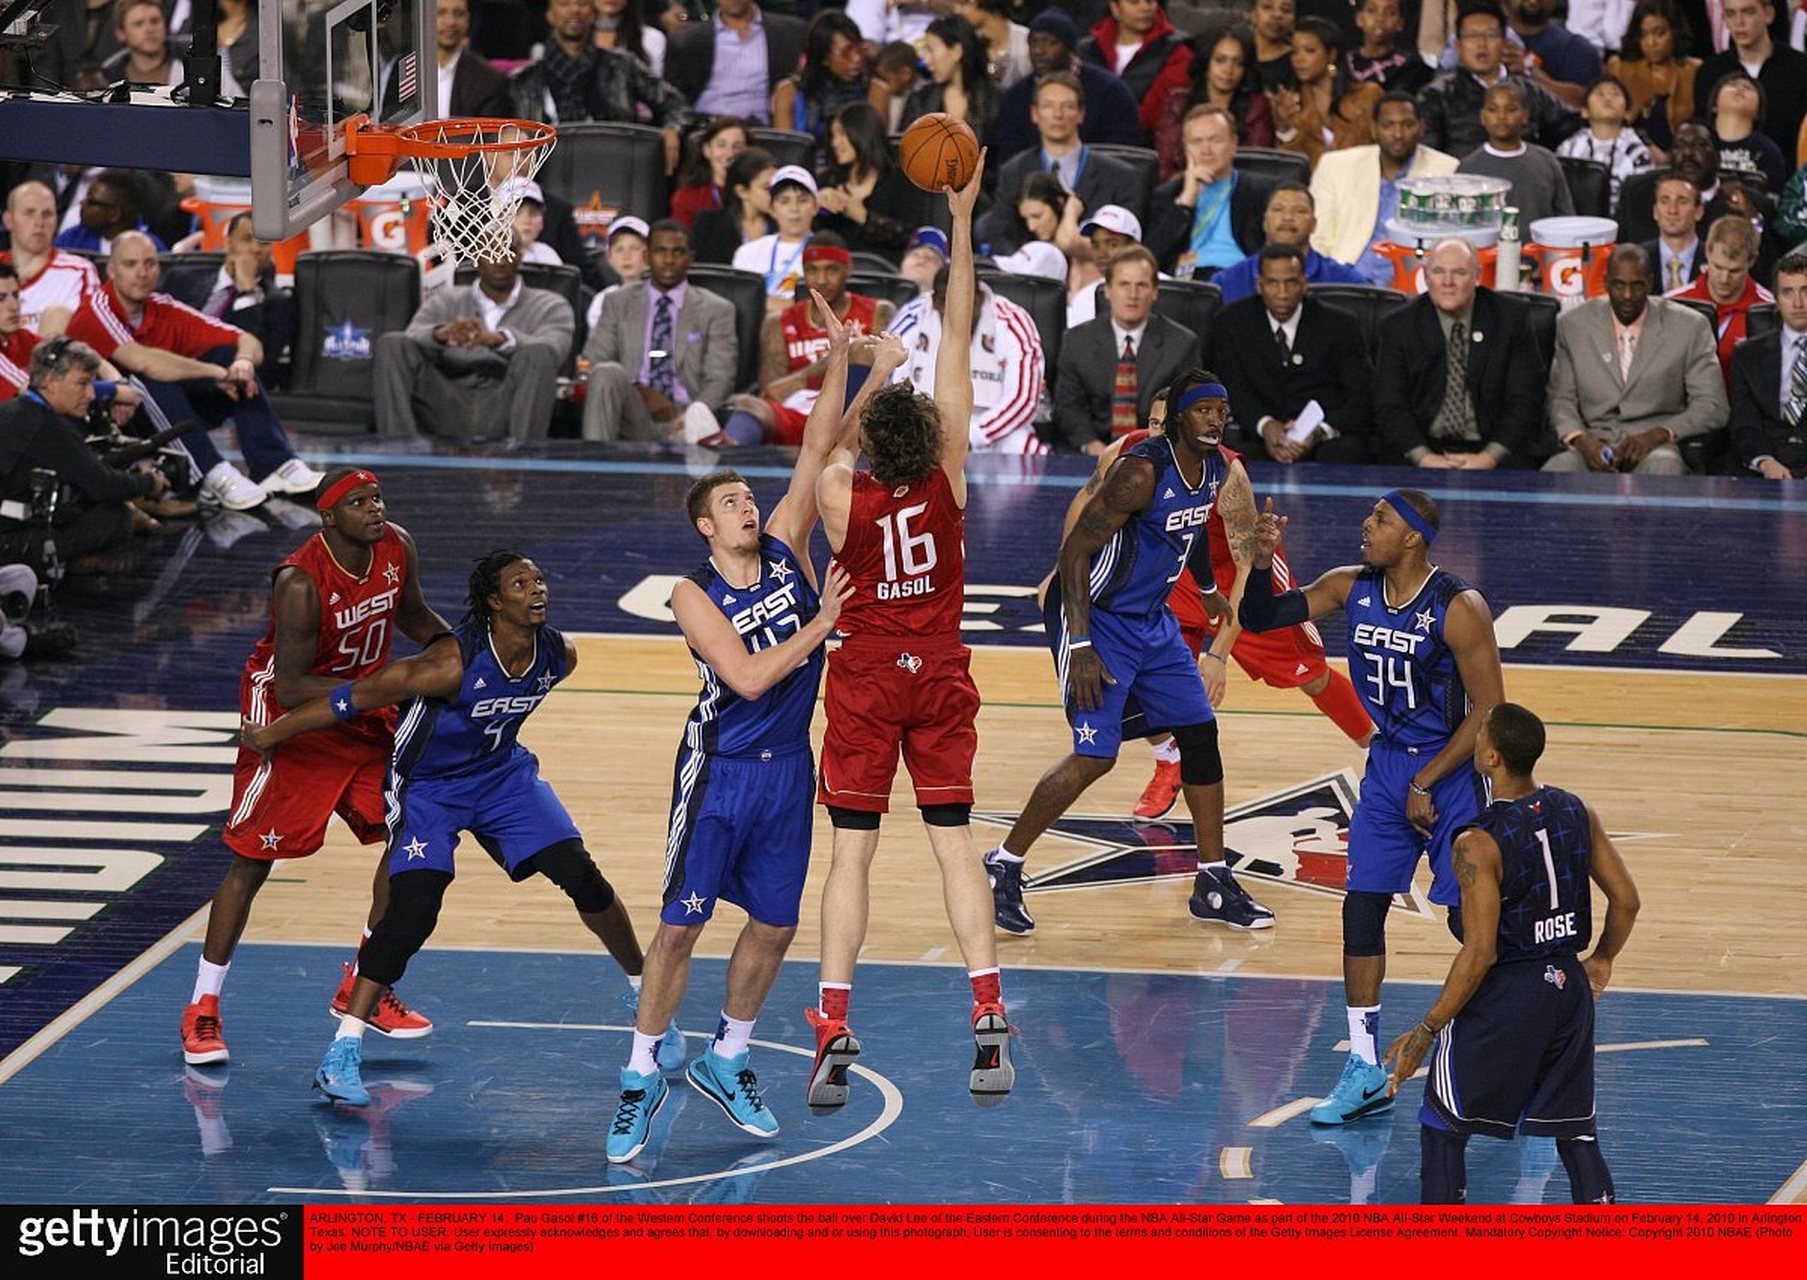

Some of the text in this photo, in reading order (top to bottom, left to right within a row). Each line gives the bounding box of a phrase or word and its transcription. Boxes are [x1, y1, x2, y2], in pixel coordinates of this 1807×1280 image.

[1165, 503, 1214, 532] EAST
[875, 502, 937, 582] 16
[1167, 533, 1194, 583] 3
[334, 587, 399, 629] WEST
[732, 582, 795, 635] EAST
[877, 575, 935, 600] GASOL
[332, 619, 386, 671] 50
[1354, 623, 1425, 655] EAST
[1364, 652, 1416, 709] 34
[471, 695, 543, 718] EAST
[1534, 828, 1559, 910] 1
[1534, 912, 1577, 944] ROSE
